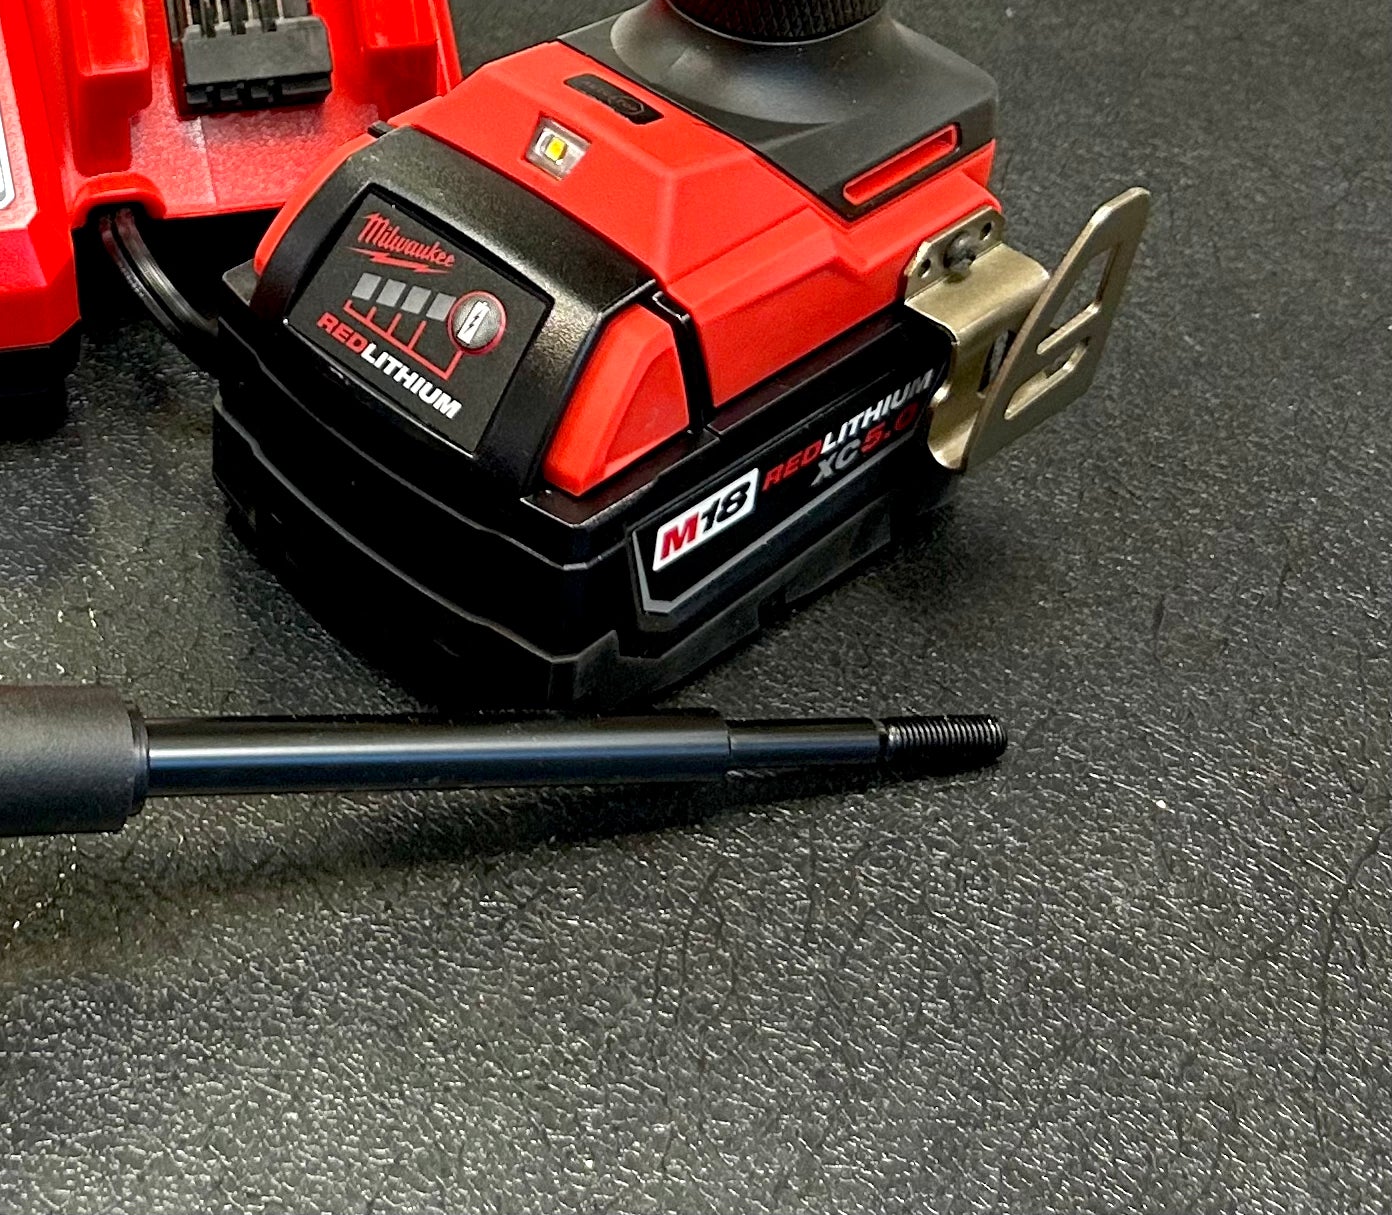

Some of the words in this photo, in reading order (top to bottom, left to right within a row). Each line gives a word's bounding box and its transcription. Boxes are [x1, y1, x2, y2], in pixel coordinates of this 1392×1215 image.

[357, 211, 456, 268] Milwaukee
[316, 311, 463, 419] REDLITHIUM
[660, 481, 751, 560] M18
[762, 369, 934, 492] REDLITHIUM
